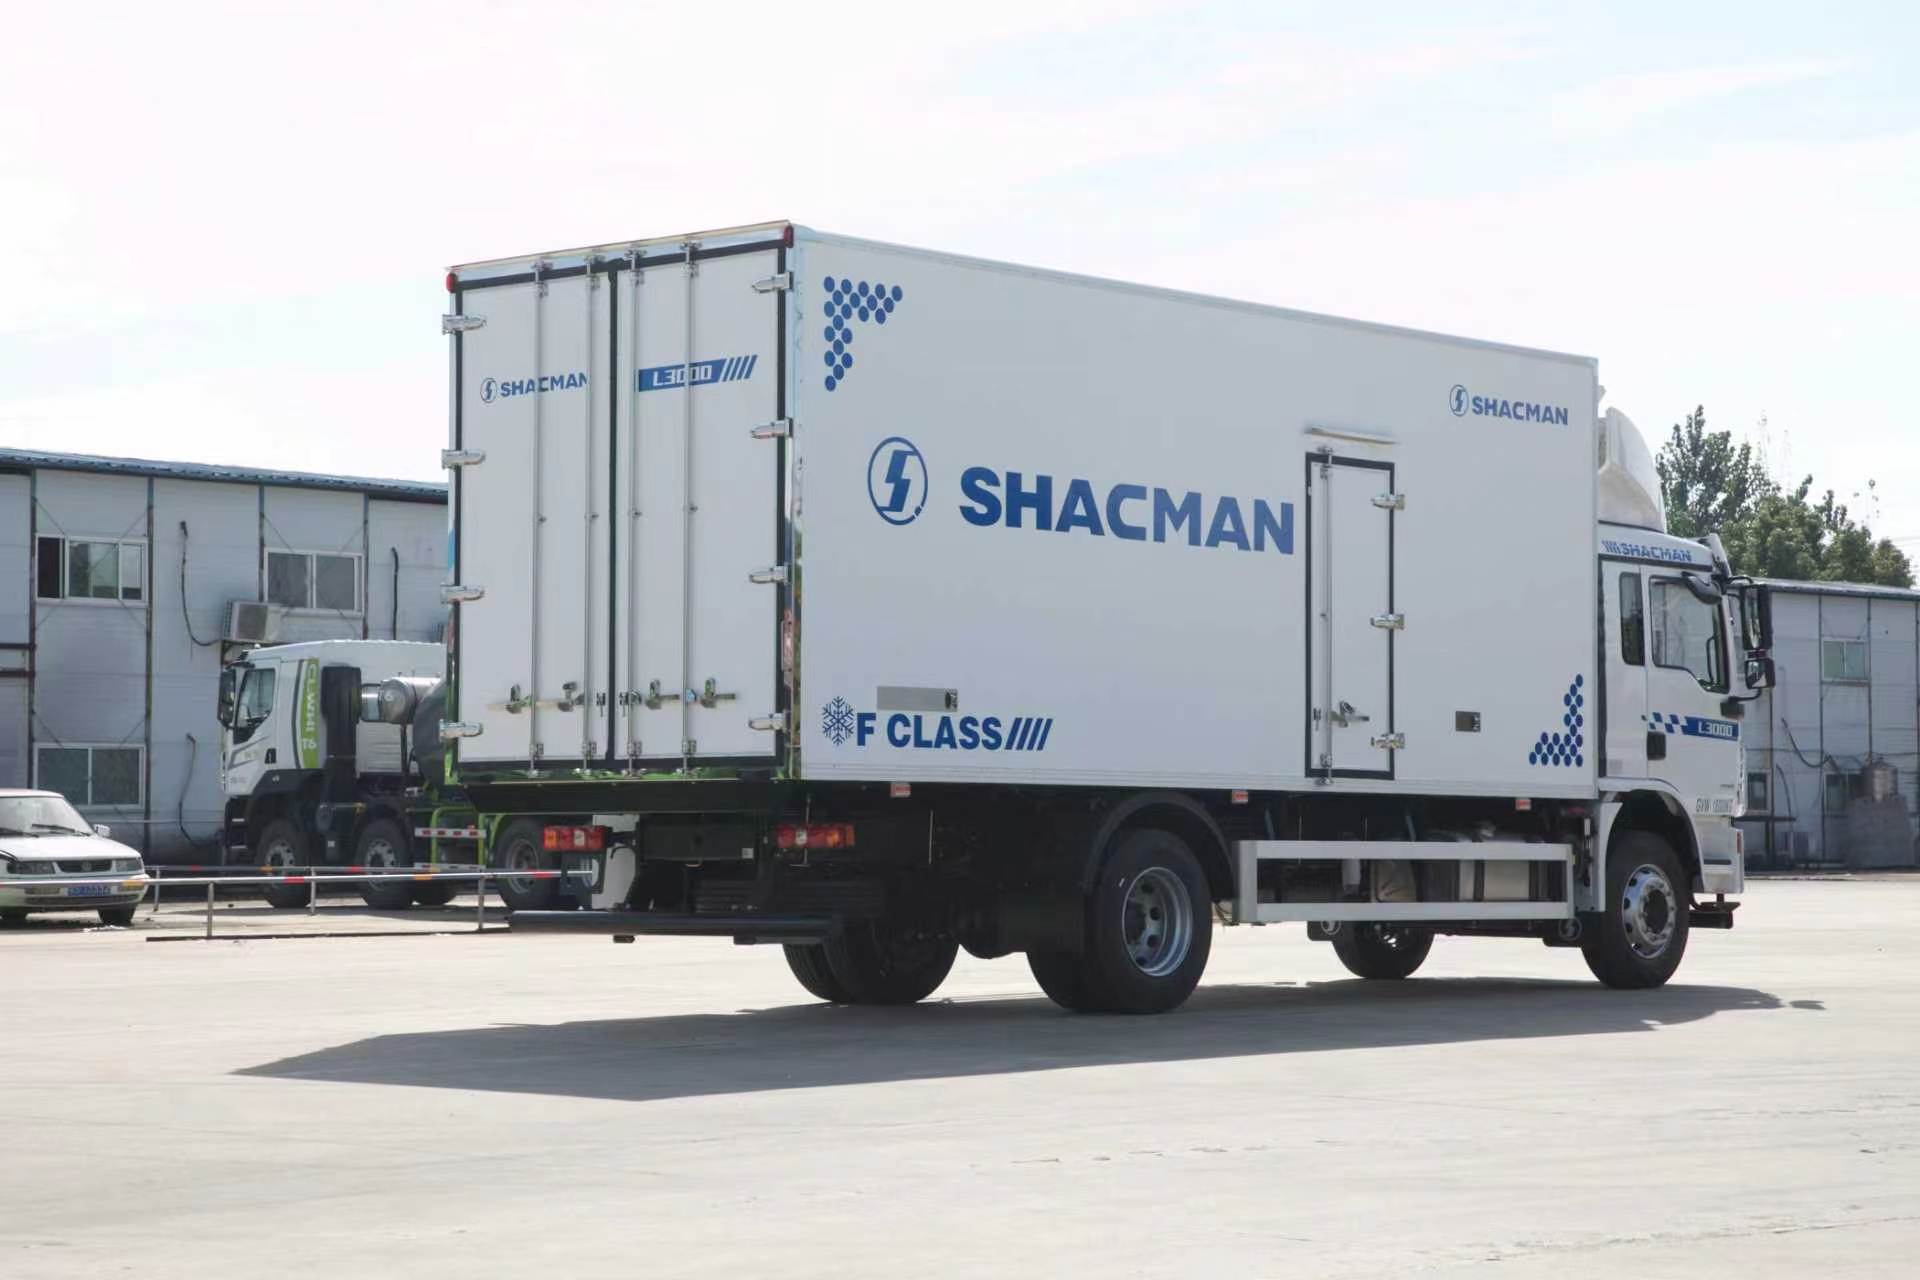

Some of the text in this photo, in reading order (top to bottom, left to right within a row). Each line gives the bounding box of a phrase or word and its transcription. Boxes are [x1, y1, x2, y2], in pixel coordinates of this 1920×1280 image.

[500, 372, 588, 397] SHACMAN
[653, 365, 713, 386] L3000
[1471, 395, 1569, 426] SHACMAN
[958, 466, 1294, 555] SHACMAN
[1619, 543, 1692, 562] SHACMAN
[856, 712, 1003, 751] F CLASS
[1697, 720, 1734, 737] L3000
